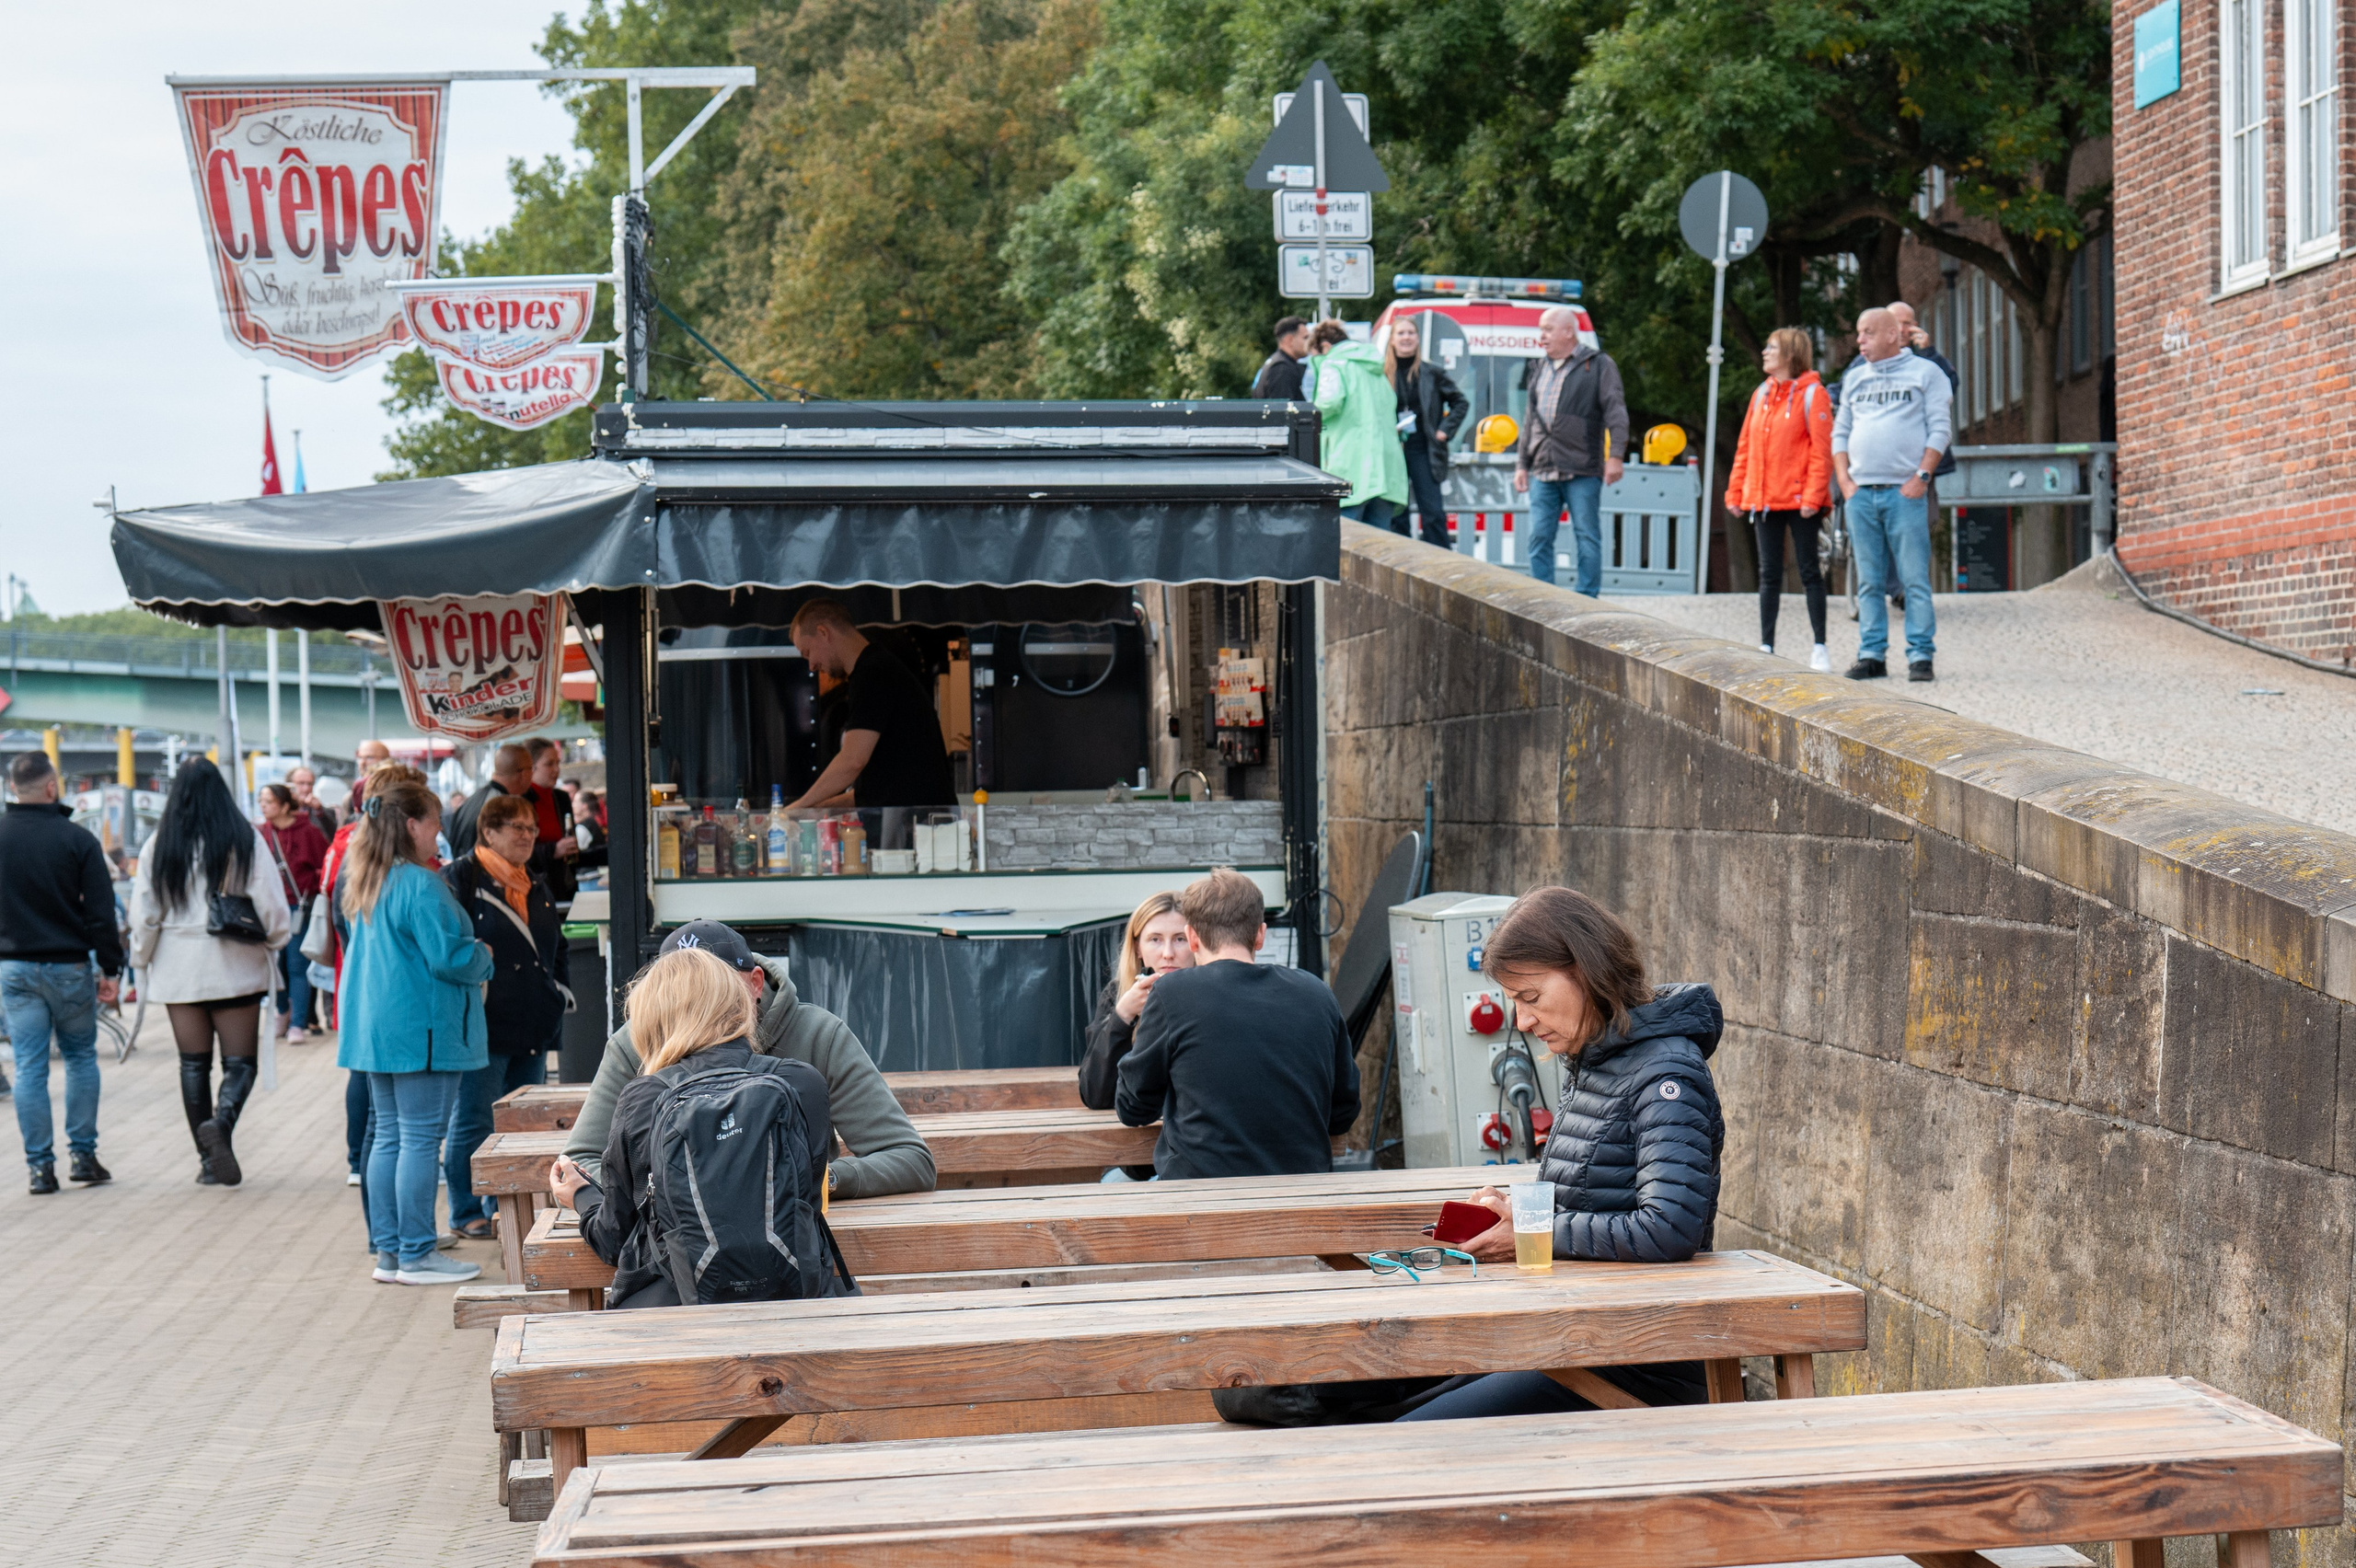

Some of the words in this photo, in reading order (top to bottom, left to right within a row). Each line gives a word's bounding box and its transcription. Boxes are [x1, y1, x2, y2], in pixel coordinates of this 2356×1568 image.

[246, 113, 384, 147] Köstliche
[207, 146, 427, 273] Crêpes
[1288, 200, 1360, 213] Liefeerkehr
[1334, 220, 1353, 233] frei
[431, 294, 564, 334] Crêpes
[508, 393, 572, 421] nutella
[395, 603, 545, 675] Crêpes
[426, 676, 535, 715] kinder
[440, 691, 535, 724] SCHOKOLADE
[1466, 920, 1483, 943] B
[716, 1127, 744, 1141] deuter
